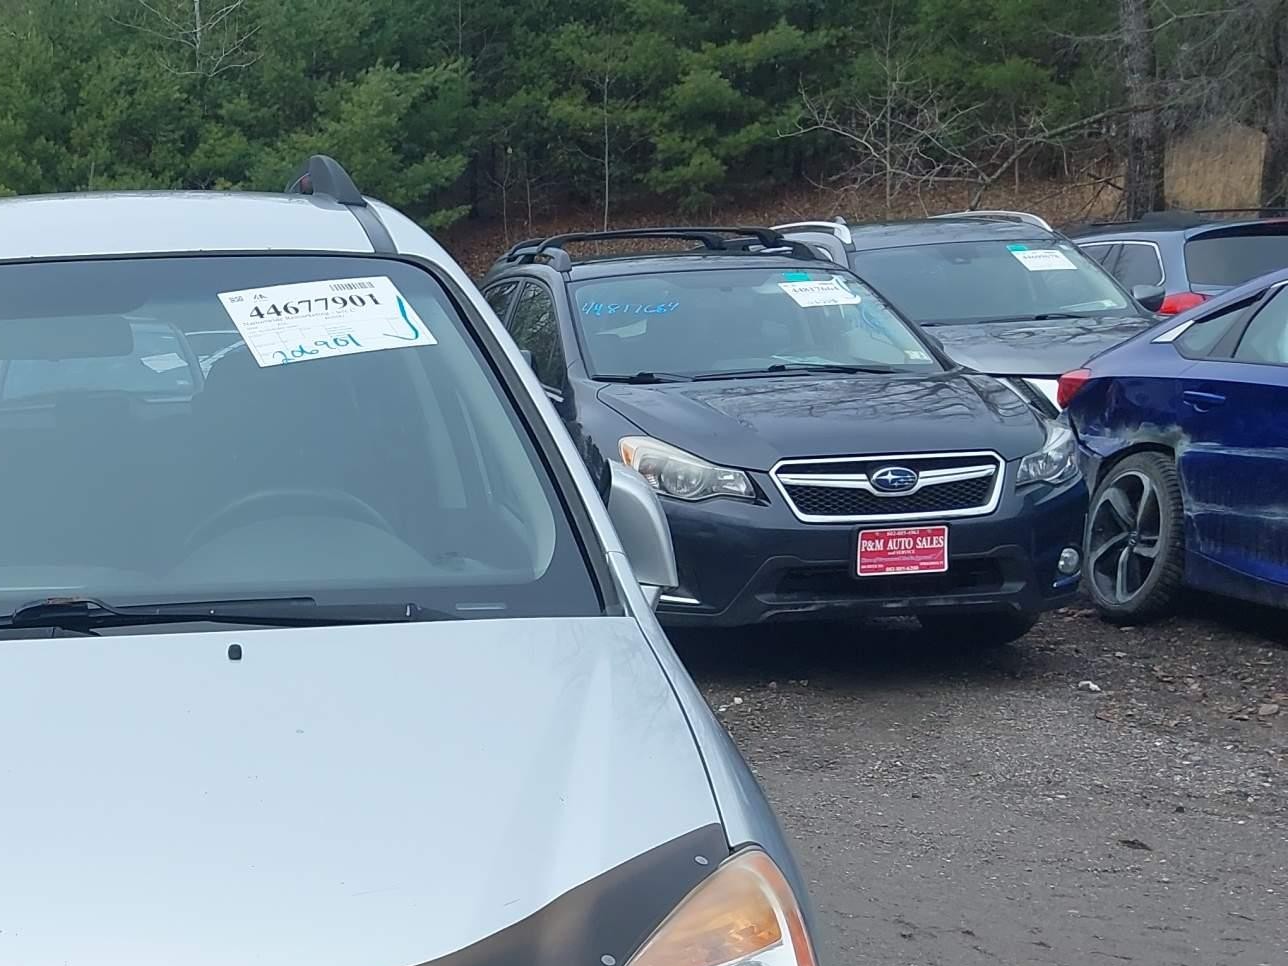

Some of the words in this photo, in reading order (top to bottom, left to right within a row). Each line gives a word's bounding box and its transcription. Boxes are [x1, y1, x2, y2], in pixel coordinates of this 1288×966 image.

[249, 291, 382, 319] 44677901
[861, 539, 884, 552] P&M
[886, 537, 913, 550] AUTO
[915, 535, 944, 549] SALES
